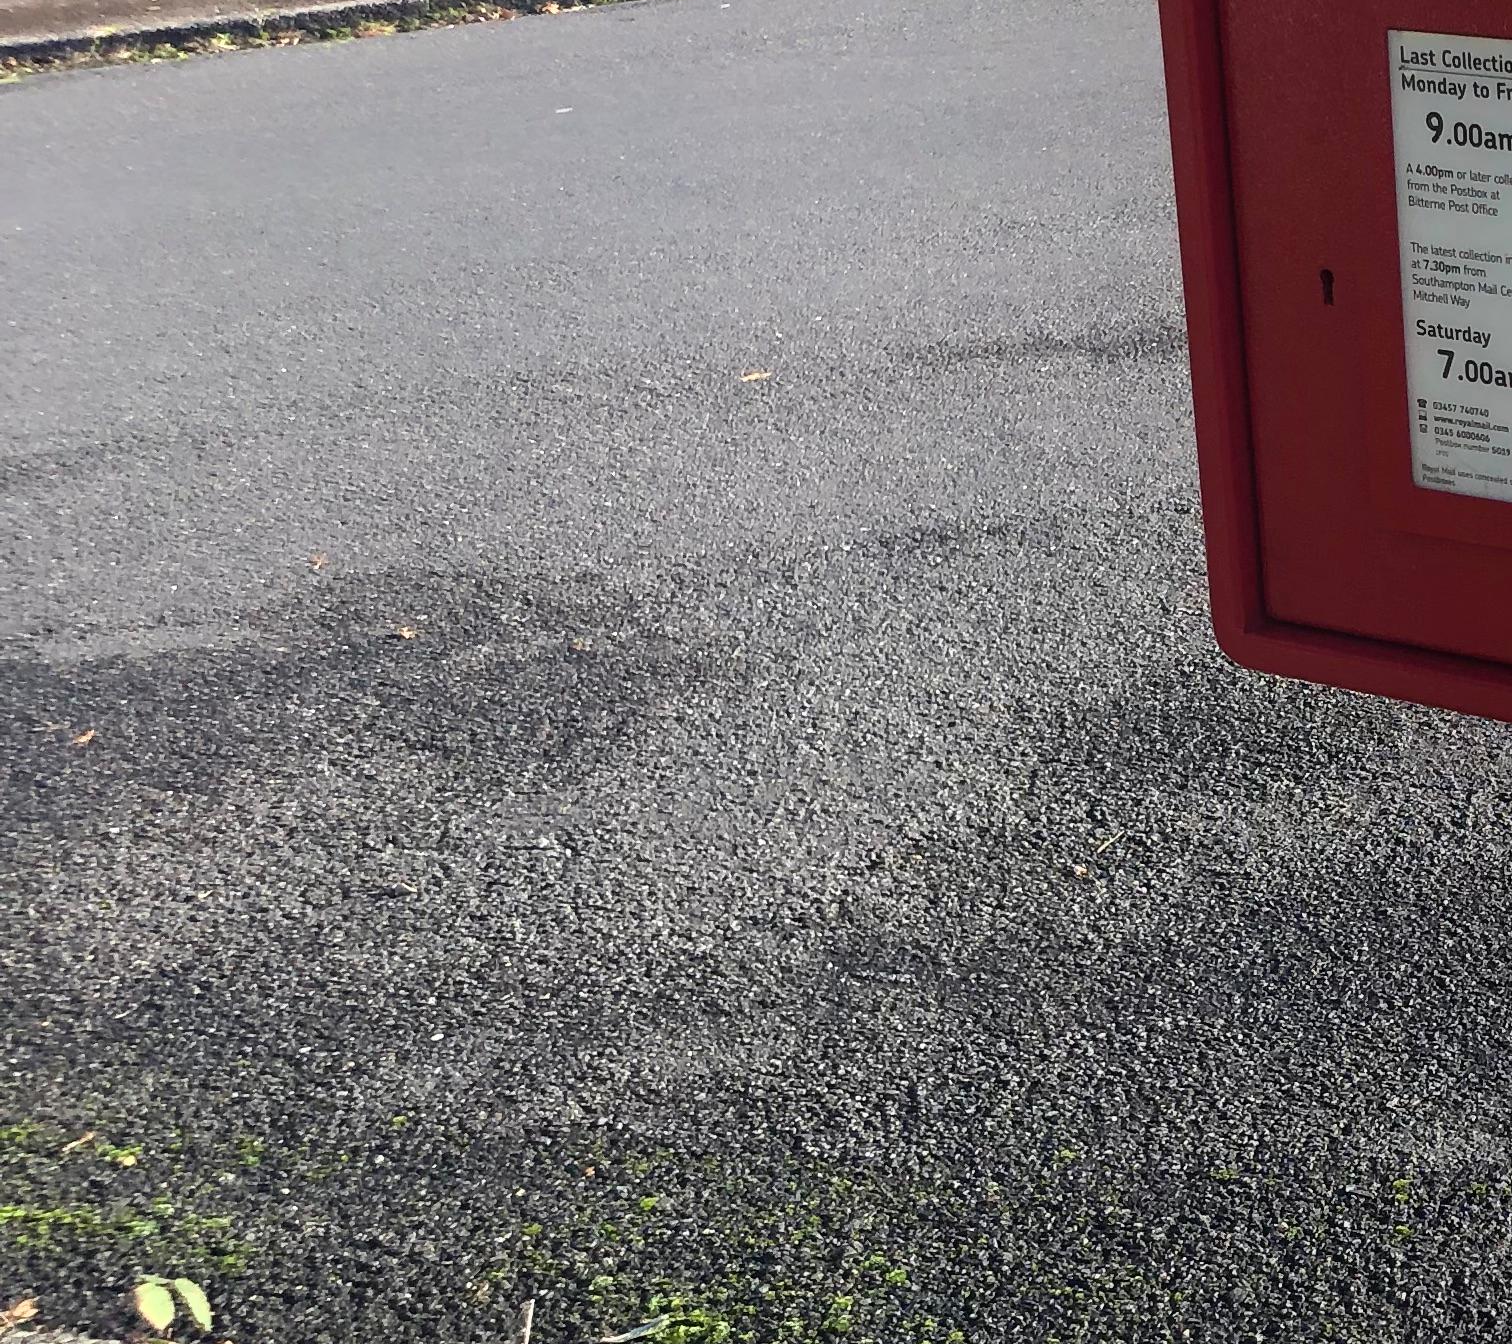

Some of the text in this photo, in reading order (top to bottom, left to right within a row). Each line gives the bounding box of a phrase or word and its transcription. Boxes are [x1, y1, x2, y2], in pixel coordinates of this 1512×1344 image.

[1400, 45, 1436, 66] Last
[1401, 73, 1466, 100] Monday
[1473, 81, 1490, 99] to
[1406, 163, 1413, 175] A
[1415, 164, 1454, 180] 4.00pm
[1456, 169, 1467, 180] or
[1469, 170, 1492, 183] later
[1407, 179, 1500, 200] from the Postbox at
[1448, 199, 1469, 214] Post
[1471, 202, 1499, 217] Office
[1410, 241, 1428, 255] The
[1431, 244, 1457, 258] latest
[1459, 249, 1502, 264] collection
[1411, 259, 1487, 278] at 7.30pm from
[1412, 274, 1476, 293] Southampton
[1478, 282, 1498, 295] Mail
[1413, 290, 1471, 309] Mitchell Way
[1416, 319, 1492, 348] Saturday
[1433, 416, 1509, 433] www.royalmail.com
